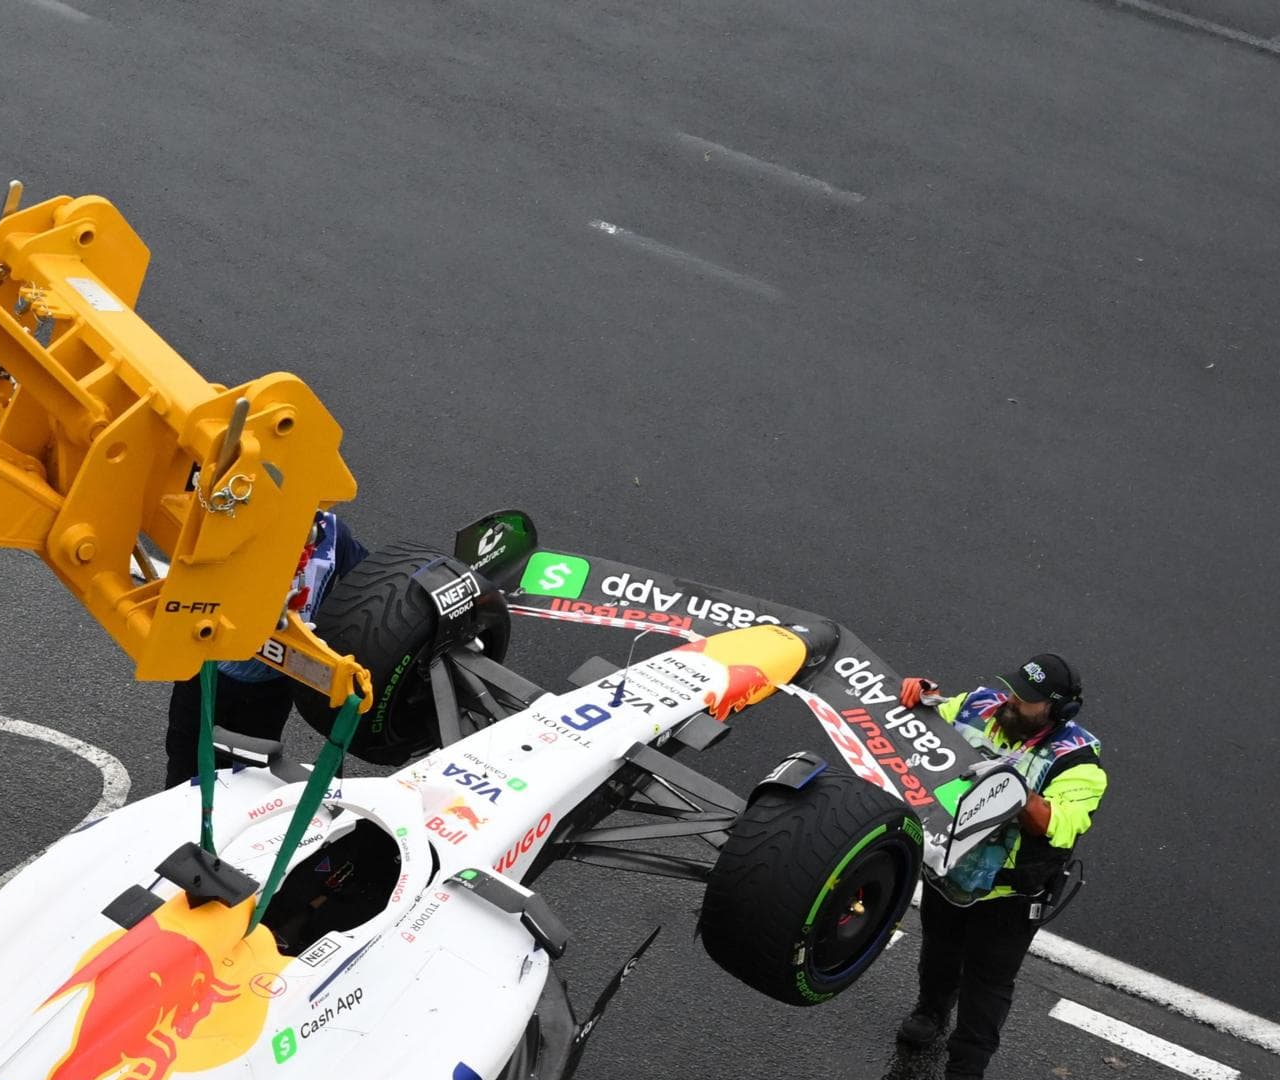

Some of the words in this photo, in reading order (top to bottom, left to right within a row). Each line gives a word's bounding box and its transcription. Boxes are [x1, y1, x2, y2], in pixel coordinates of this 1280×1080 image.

[165, 601, 221, 614] Q-FIT
[440, 579, 473, 609] NEFT
[601, 573, 683, 612] App
[448, 601, 474, 620] VODKA
[664, 657, 711, 683] Mobil
[834, 657, 897, 705] App
[532, 712, 592, 749] TUDOR
[561, 704, 612, 731] 6
[840, 708, 896, 756] Bull
[884, 706, 956, 771] Cash
[442, 763, 502, 805] VISA
[879, 756, 935, 807] Red
[248, 798, 284, 820] HUGO
[959, 797, 986, 826] Cash
[987, 777, 1010, 803] App
[425, 816, 468, 845] Bull
[392, 873, 409, 902] HUGO
[410, 902, 440, 932] TUDOR
[304, 941, 336, 964] NEFT
[300, 1007, 334, 1039] Cash
[336, 987, 363, 1014] App
